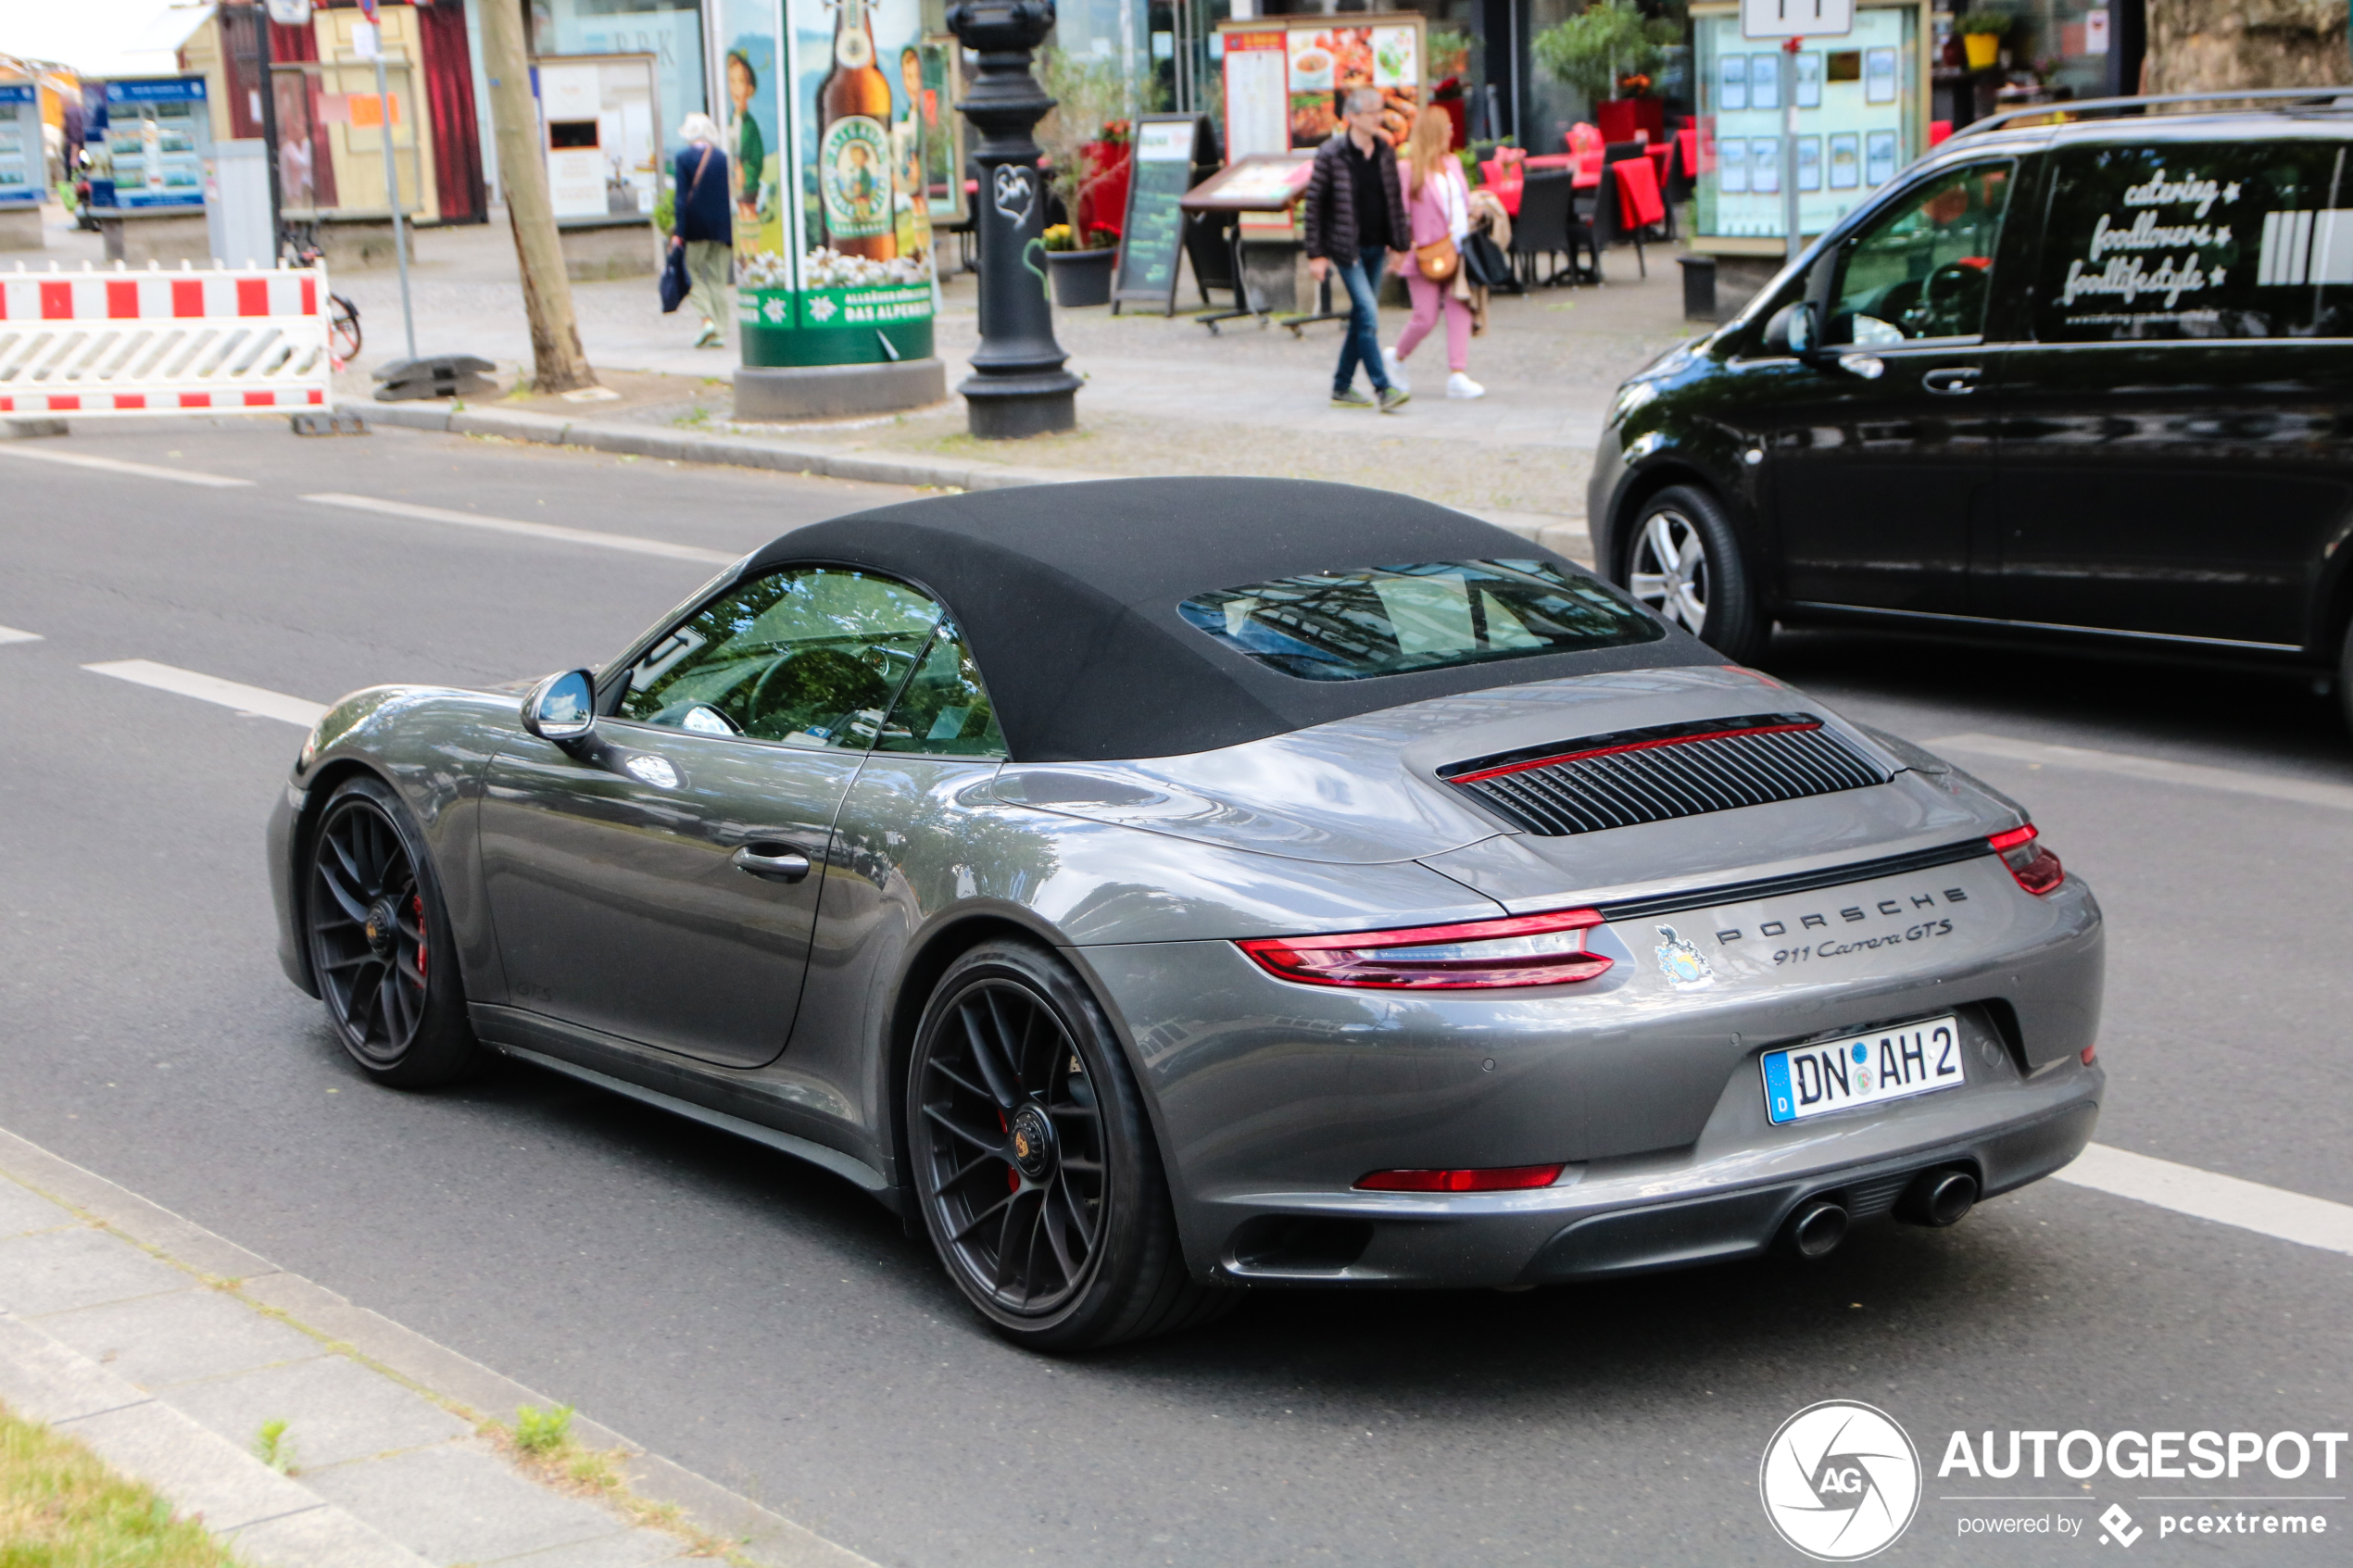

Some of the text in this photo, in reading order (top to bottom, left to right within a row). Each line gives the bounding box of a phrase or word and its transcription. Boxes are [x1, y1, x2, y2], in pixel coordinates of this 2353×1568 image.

[2123, 169, 2220, 219] catering
[2089, 209, 2213, 262] foodlovers
[2063, 252, 2206, 308] foodlifestyle
[844, 305, 875, 322] DAS
[1716, 887, 1968, 946] PORSCHE
[1773, 918, 1954, 965] 911 Carrera GTS
[1793, 1026, 1957, 1106] DN AH 2
[1777, 1097, 1789, 1112] D
